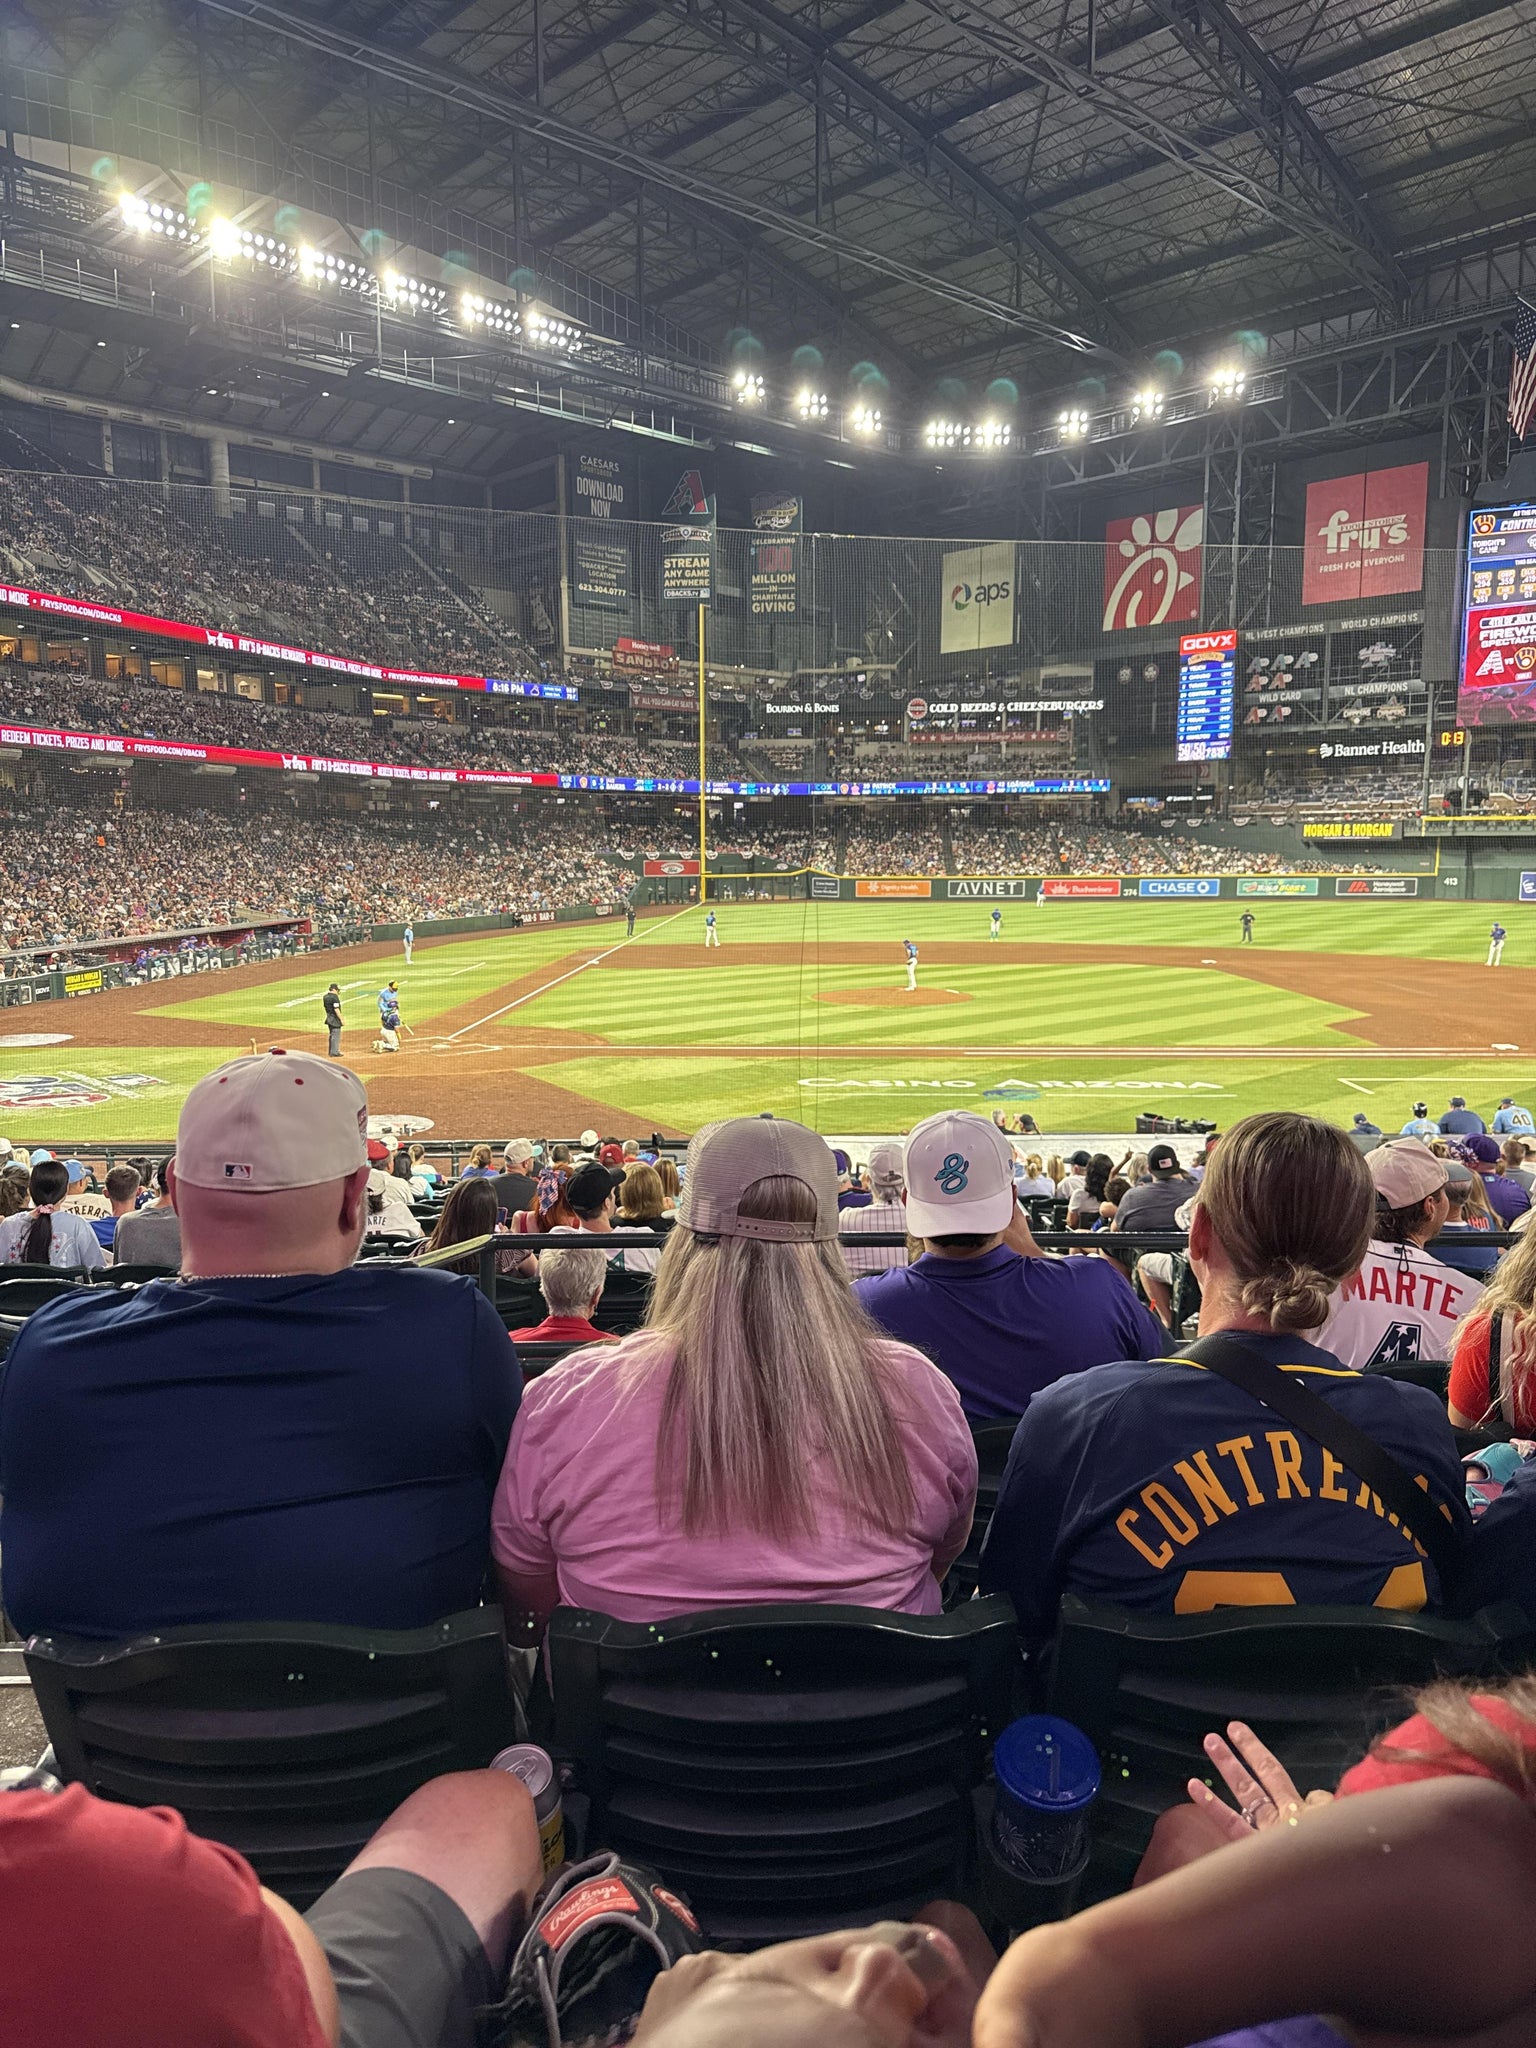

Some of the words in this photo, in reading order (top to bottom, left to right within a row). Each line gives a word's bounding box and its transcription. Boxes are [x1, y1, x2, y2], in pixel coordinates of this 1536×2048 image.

[580, 455, 620, 472] CAESARS
[576, 476, 623, 502] DOWNLOAD
[591, 498, 611, 518] NOW
[752, 537, 796, 545] CELEBRATING
[664, 557, 710, 568] STREAM
[1320, 562, 1343, 573] FRESH
[1345, 560, 1362, 570] FOR
[1364, 554, 1405, 567] EVERYONE
[664, 570, 682, 578] ANY
[684, 570, 710, 578] GAME
[752, 574, 796, 584] MILLION
[578, 583, 626, 596] 623.304.0777
[664, 579, 710, 587] ANYWHERE
[974, 582, 1010, 606] aps
[8, 591, 30, 606] MORE
[40, 598, 122, 622] FRYSFOOD.COM/DBACKS
[752, 602, 796, 612] GIVING
[1341, 618, 1368, 630] WORLD
[1370, 613, 1418, 627] CHAMPIONS
[1256, 629, 1278, 639] WEST
[1280, 623, 1325, 638] CHAMPIONS
[632, 641, 660, 652] Honeywell
[1183, 634, 1234, 651] GOVX
[616, 652, 678, 670] SANDLOT
[388, 672, 459, 687] FRYSFOOD.COM/DBACKS
[492, 682, 510, 693] 8:16
[510, 684, 524, 694] PM
[1344, 686, 1356, 696] NL
[1358, 682, 1408, 695] CHAMPIONS
[1258, 692, 1278, 703] WILD
[1280, 690, 1302, 702] CARD
[804, 702, 813, 713] &
[814, 703, 840, 713] BONES
[930, 703, 958, 714] COLD
[960, 702, 996, 712] BEERS
[998, 702, 1005, 712] &
[1006, 700, 1104, 712] CHEESEBURGERS
[1, 729, 30, 744] REDEEM
[32, 732, 64, 748] TICKETS,
[65, 736, 90, 750] PRIZES
[91, 738, 106, 751] AND
[106, 740, 125, 752] MORE
[134, 743, 207, 758] FRYSFOOD.COM/DBACKS
[1334, 744, 1381, 758] Banner
[1382, 739, 1425, 754] Health
[1304, 823, 1342, 837] MORGAN
[1343, 823, 1351, 836] &
[1352, 823, 1392, 837] MORGAN
[880, 884, 900, 892] Dignity
[956, 882, 1017, 895] AVNET
[1148, 882, 1195, 892] CHASE
[1444, 878, 1458, 886] 413
[796, 1076, 977, 1088] CASINO
[992, 1078, 1226, 1090] ARIZONA
[1512, 1114, 1532, 1126] 40
[1341, 1266, 1464, 1320] MARTE
[550, 1884, 619, 1931] Rawlings
